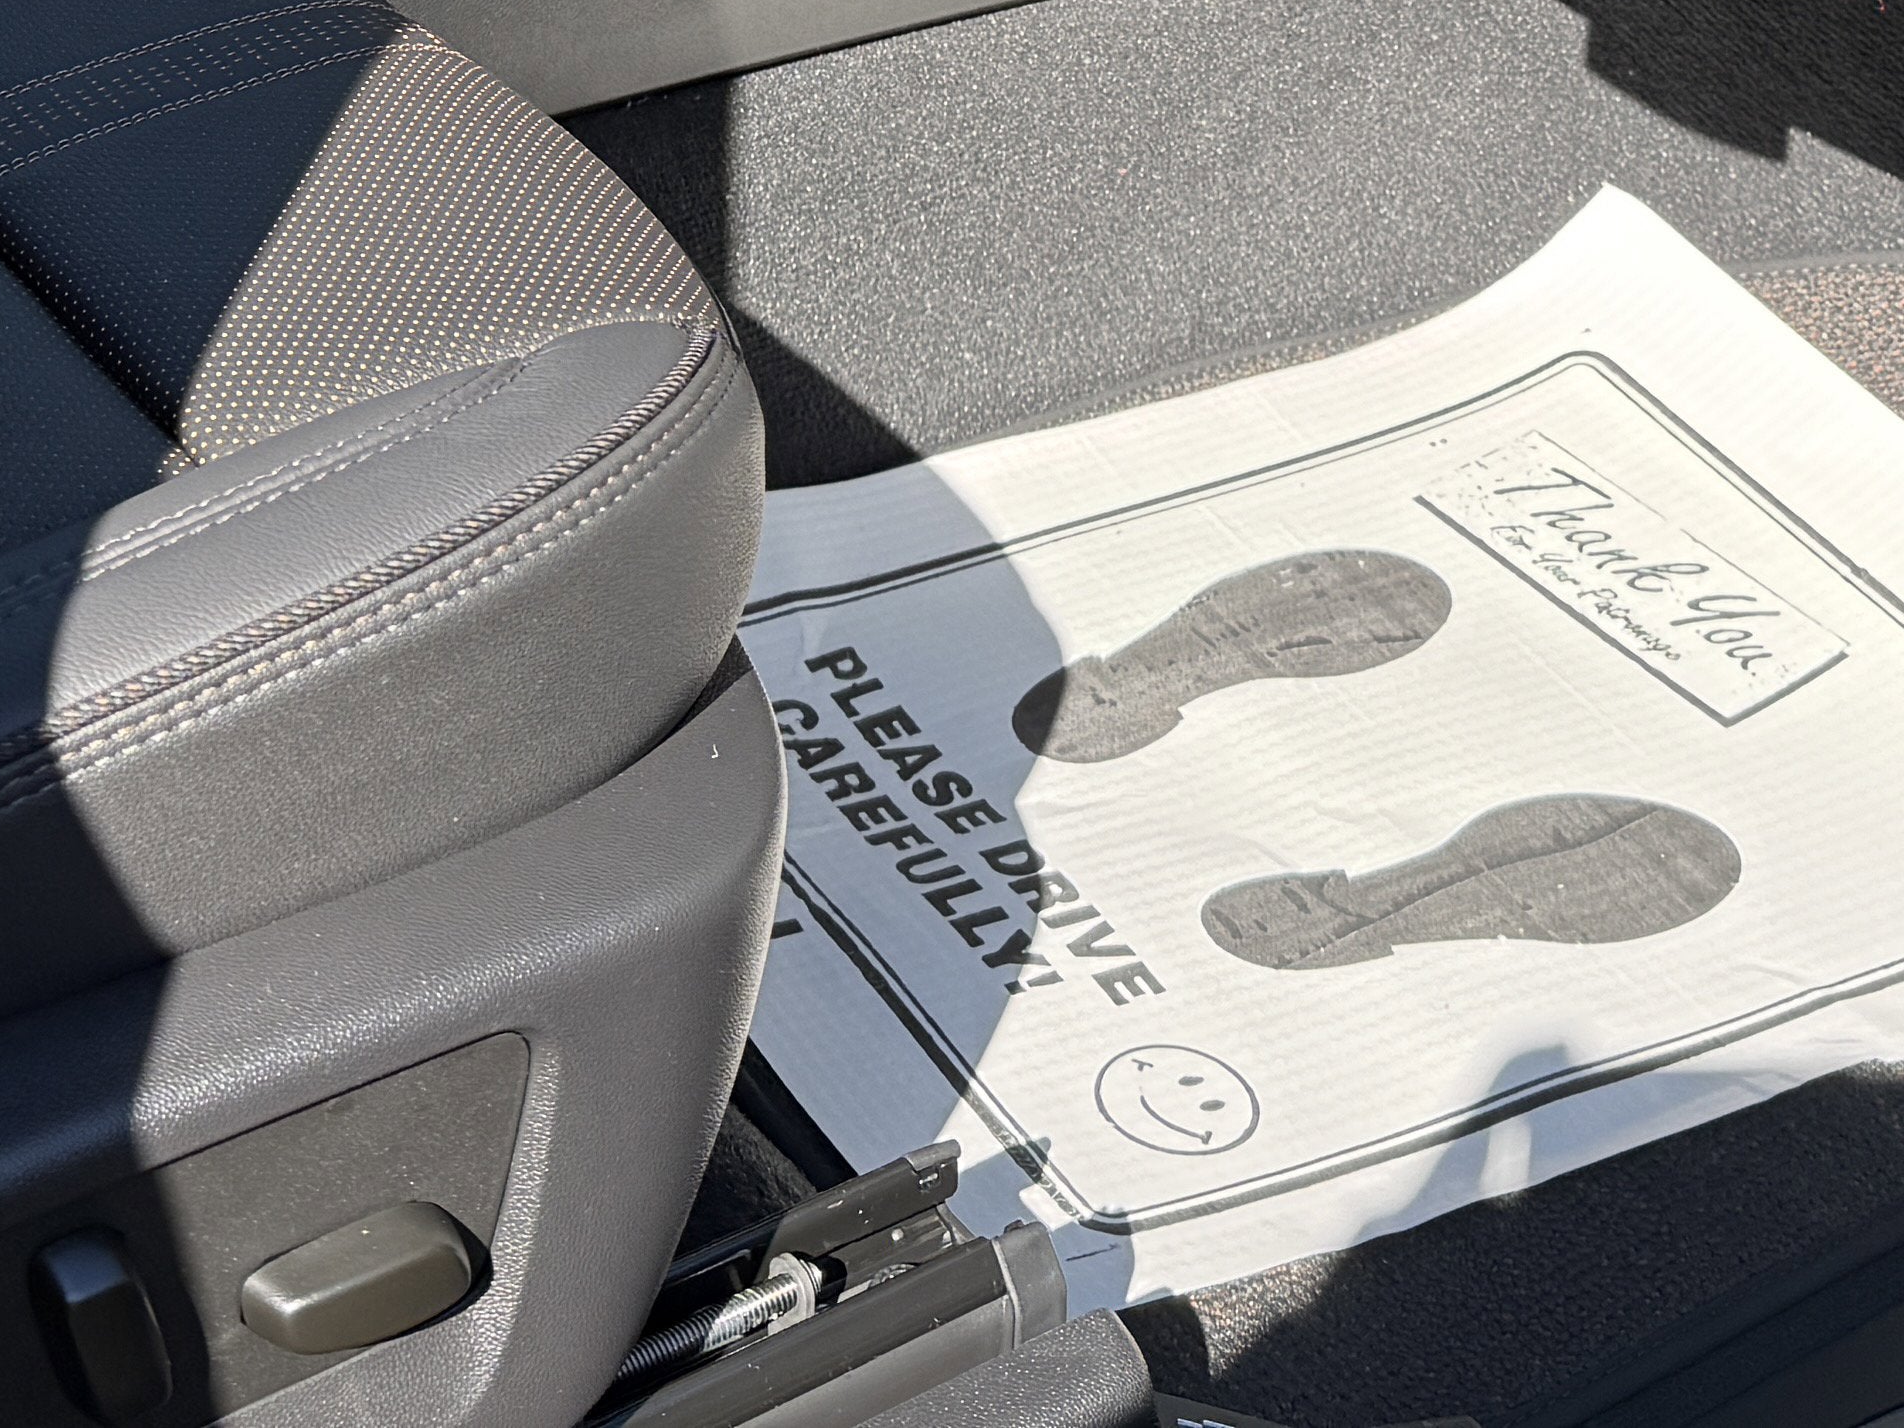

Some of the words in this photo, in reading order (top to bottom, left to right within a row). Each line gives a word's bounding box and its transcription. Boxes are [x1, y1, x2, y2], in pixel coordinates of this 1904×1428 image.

[1493, 466, 1710, 593] Thank
[772, 698, 1064, 996] CAREFULLY!
[804, 646, 1008, 835] PLEASE
[978, 839, 1167, 1007] DRIVE
